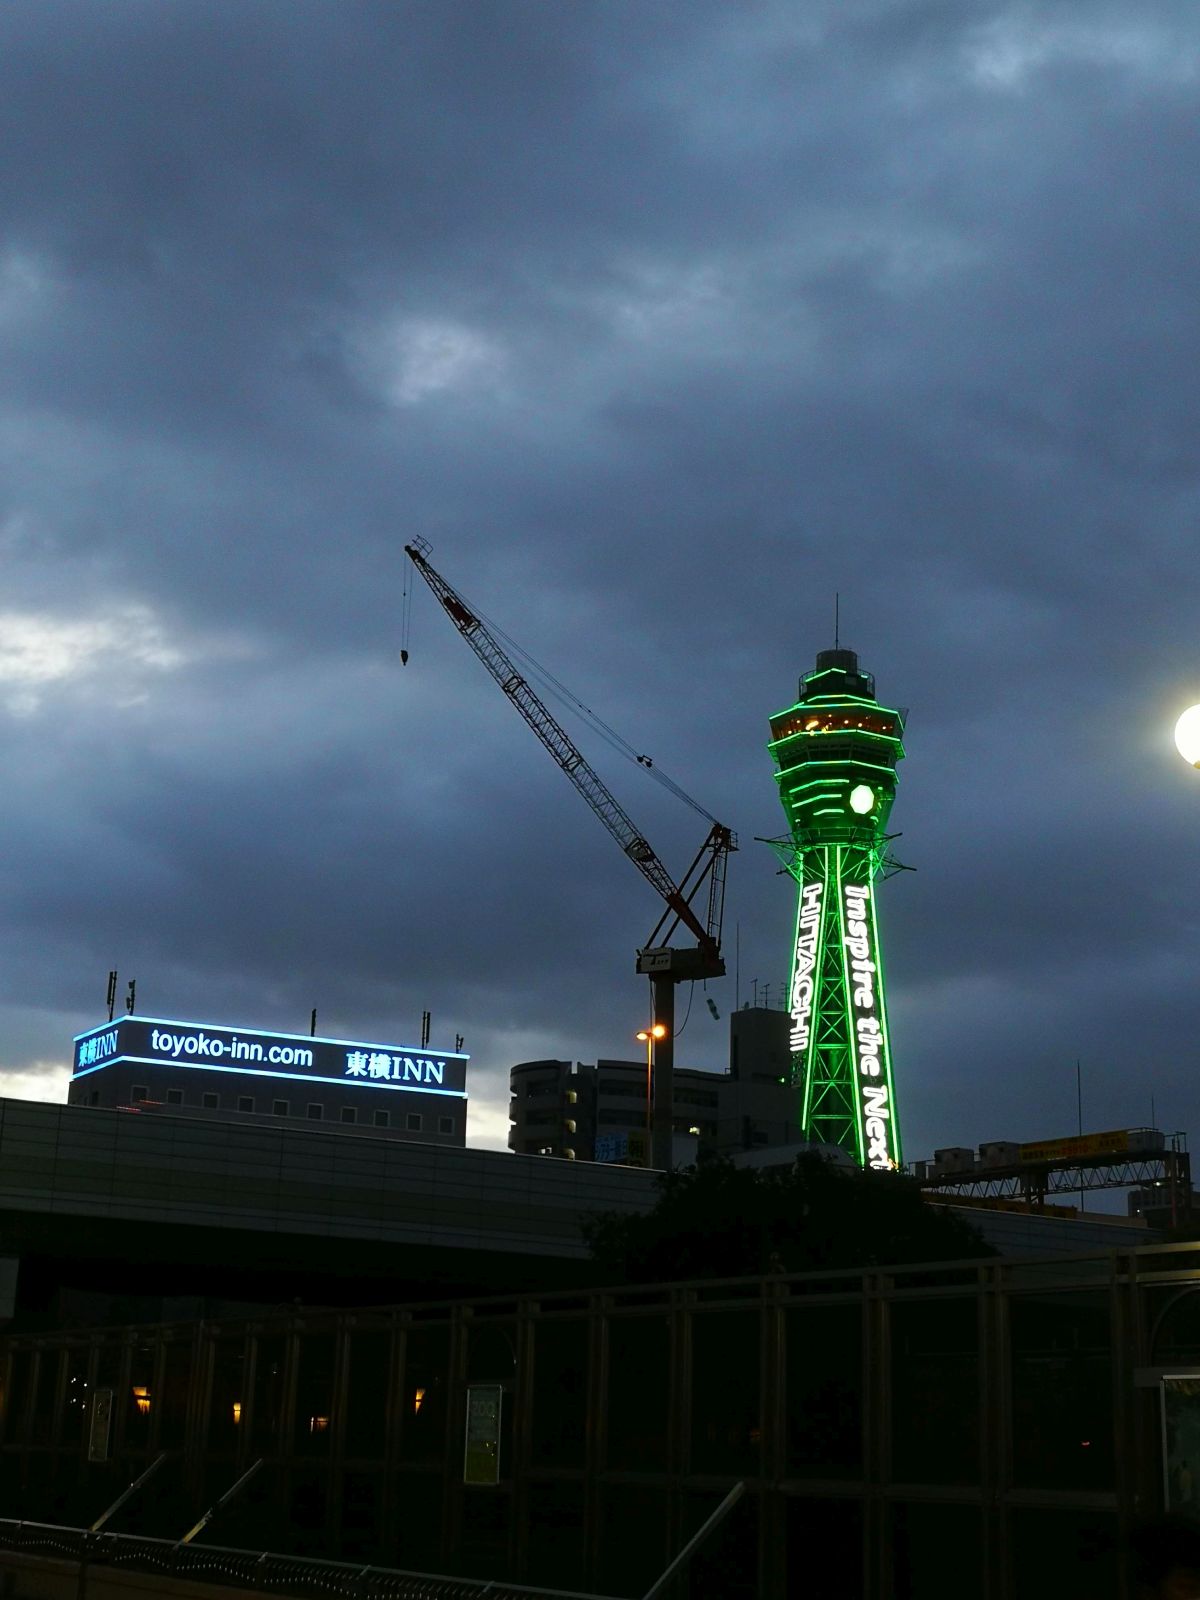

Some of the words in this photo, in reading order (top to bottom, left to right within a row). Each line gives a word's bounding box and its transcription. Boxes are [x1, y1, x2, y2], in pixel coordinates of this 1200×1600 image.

[790, 883, 823, 1052] HITACHI
[844, 885, 877, 1009] Inspire
[78, 1029, 119, 1067] 東横INN
[151, 1029, 313, 1067] toyoko-inn.com
[345, 1050, 446, 1084] 東横INN
[856, 1016, 883, 1077] the
[862, 1084, 892, 1171] Next
